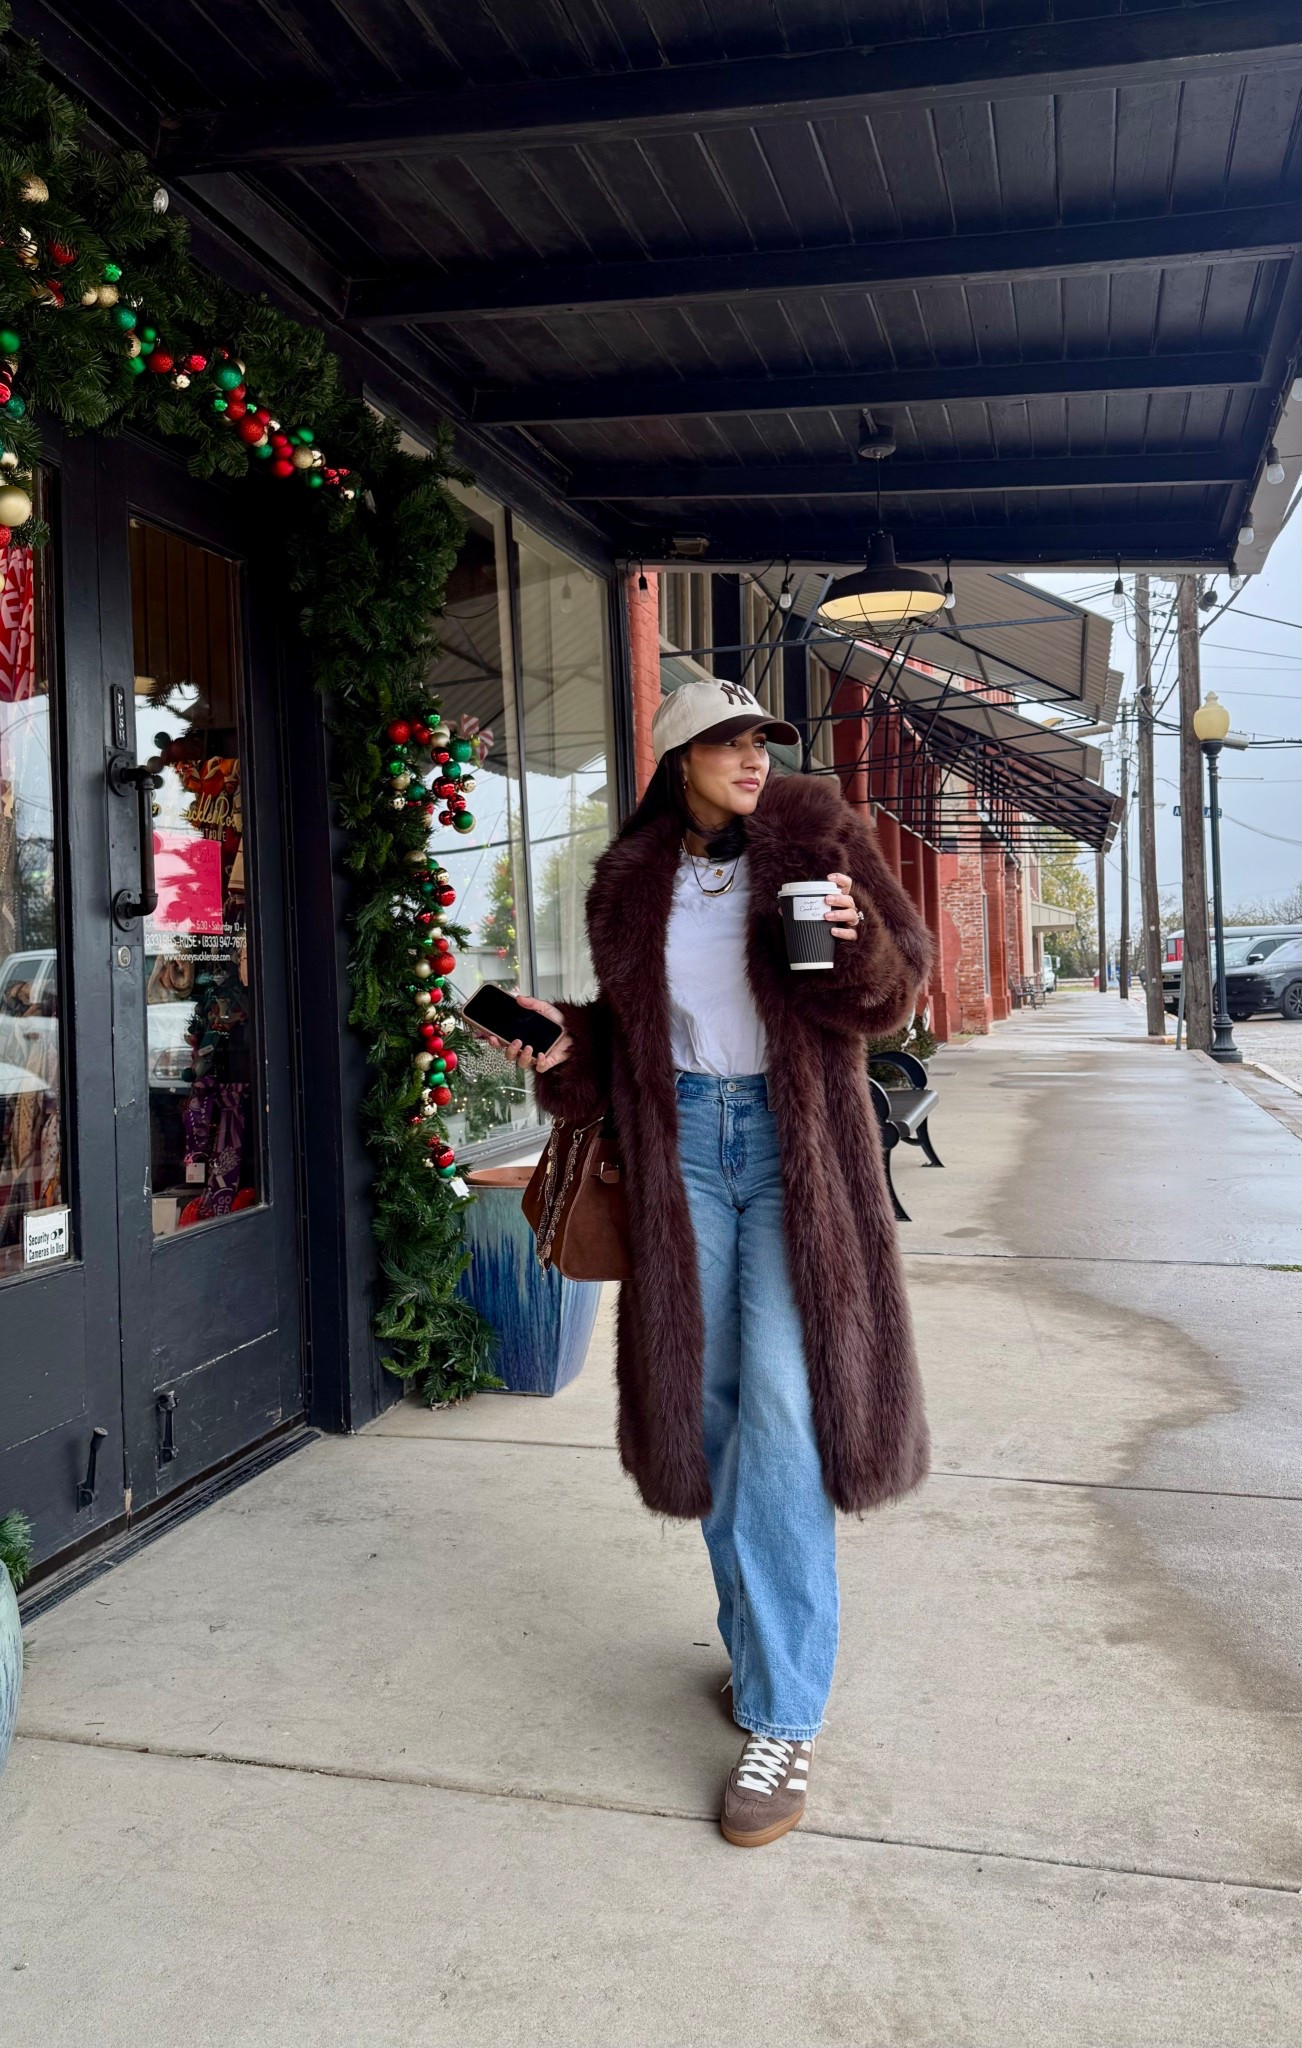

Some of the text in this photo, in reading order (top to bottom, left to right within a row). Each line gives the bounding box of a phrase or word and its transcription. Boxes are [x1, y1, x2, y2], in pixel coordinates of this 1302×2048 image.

[720, 682, 754, 705] NY
[117, 693, 125, 741] PUSH
[196, 921, 208, 930] 5:30
[211, 921, 233, 933] Saturday
[233, 922, 240, 932] 10
[202, 935, 219, 948] (833)
[219, 936, 247, 949] 947-7673
[164, 951, 231, 963] www.honeysucklerose.com
[218, 1195, 232, 1205] GO
[29, 1232, 50, 1246] Security
[29, 1247, 50, 1260] Cameras
[56, 1242, 64, 1253] Use
